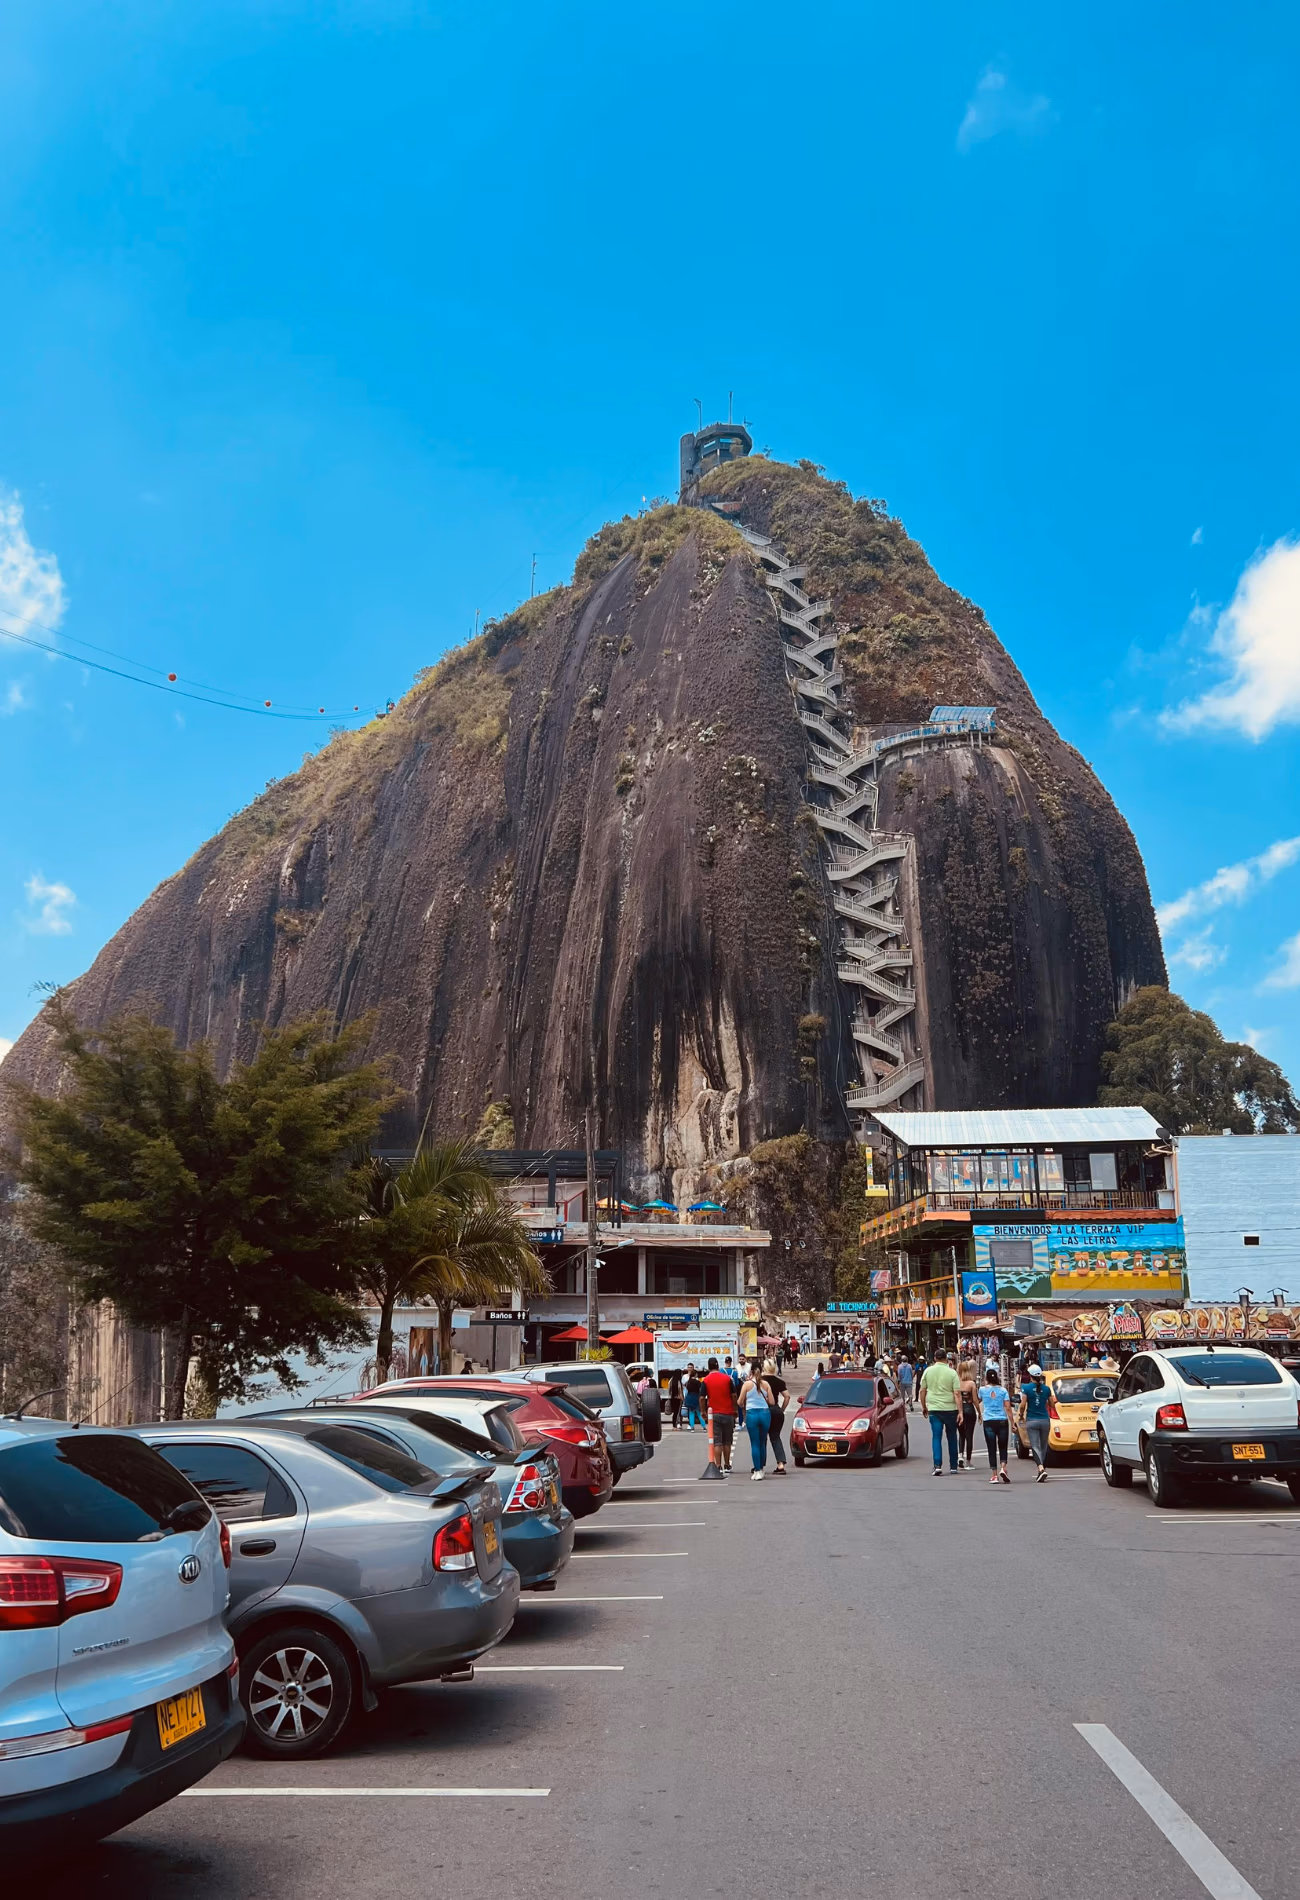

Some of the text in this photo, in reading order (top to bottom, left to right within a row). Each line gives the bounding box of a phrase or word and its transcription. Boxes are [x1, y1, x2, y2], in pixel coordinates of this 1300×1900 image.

[994, 1225, 1145, 1235] BIENVENIDOS A LA TERRAZA VIP
[1061, 1236, 1118, 1245] LAS LETRAS
[700, 1298, 745, 1309] MICHELADAS
[701, 1309, 743, 1320] CON MANGO
[184, 1559, 200, 1579] KIA
